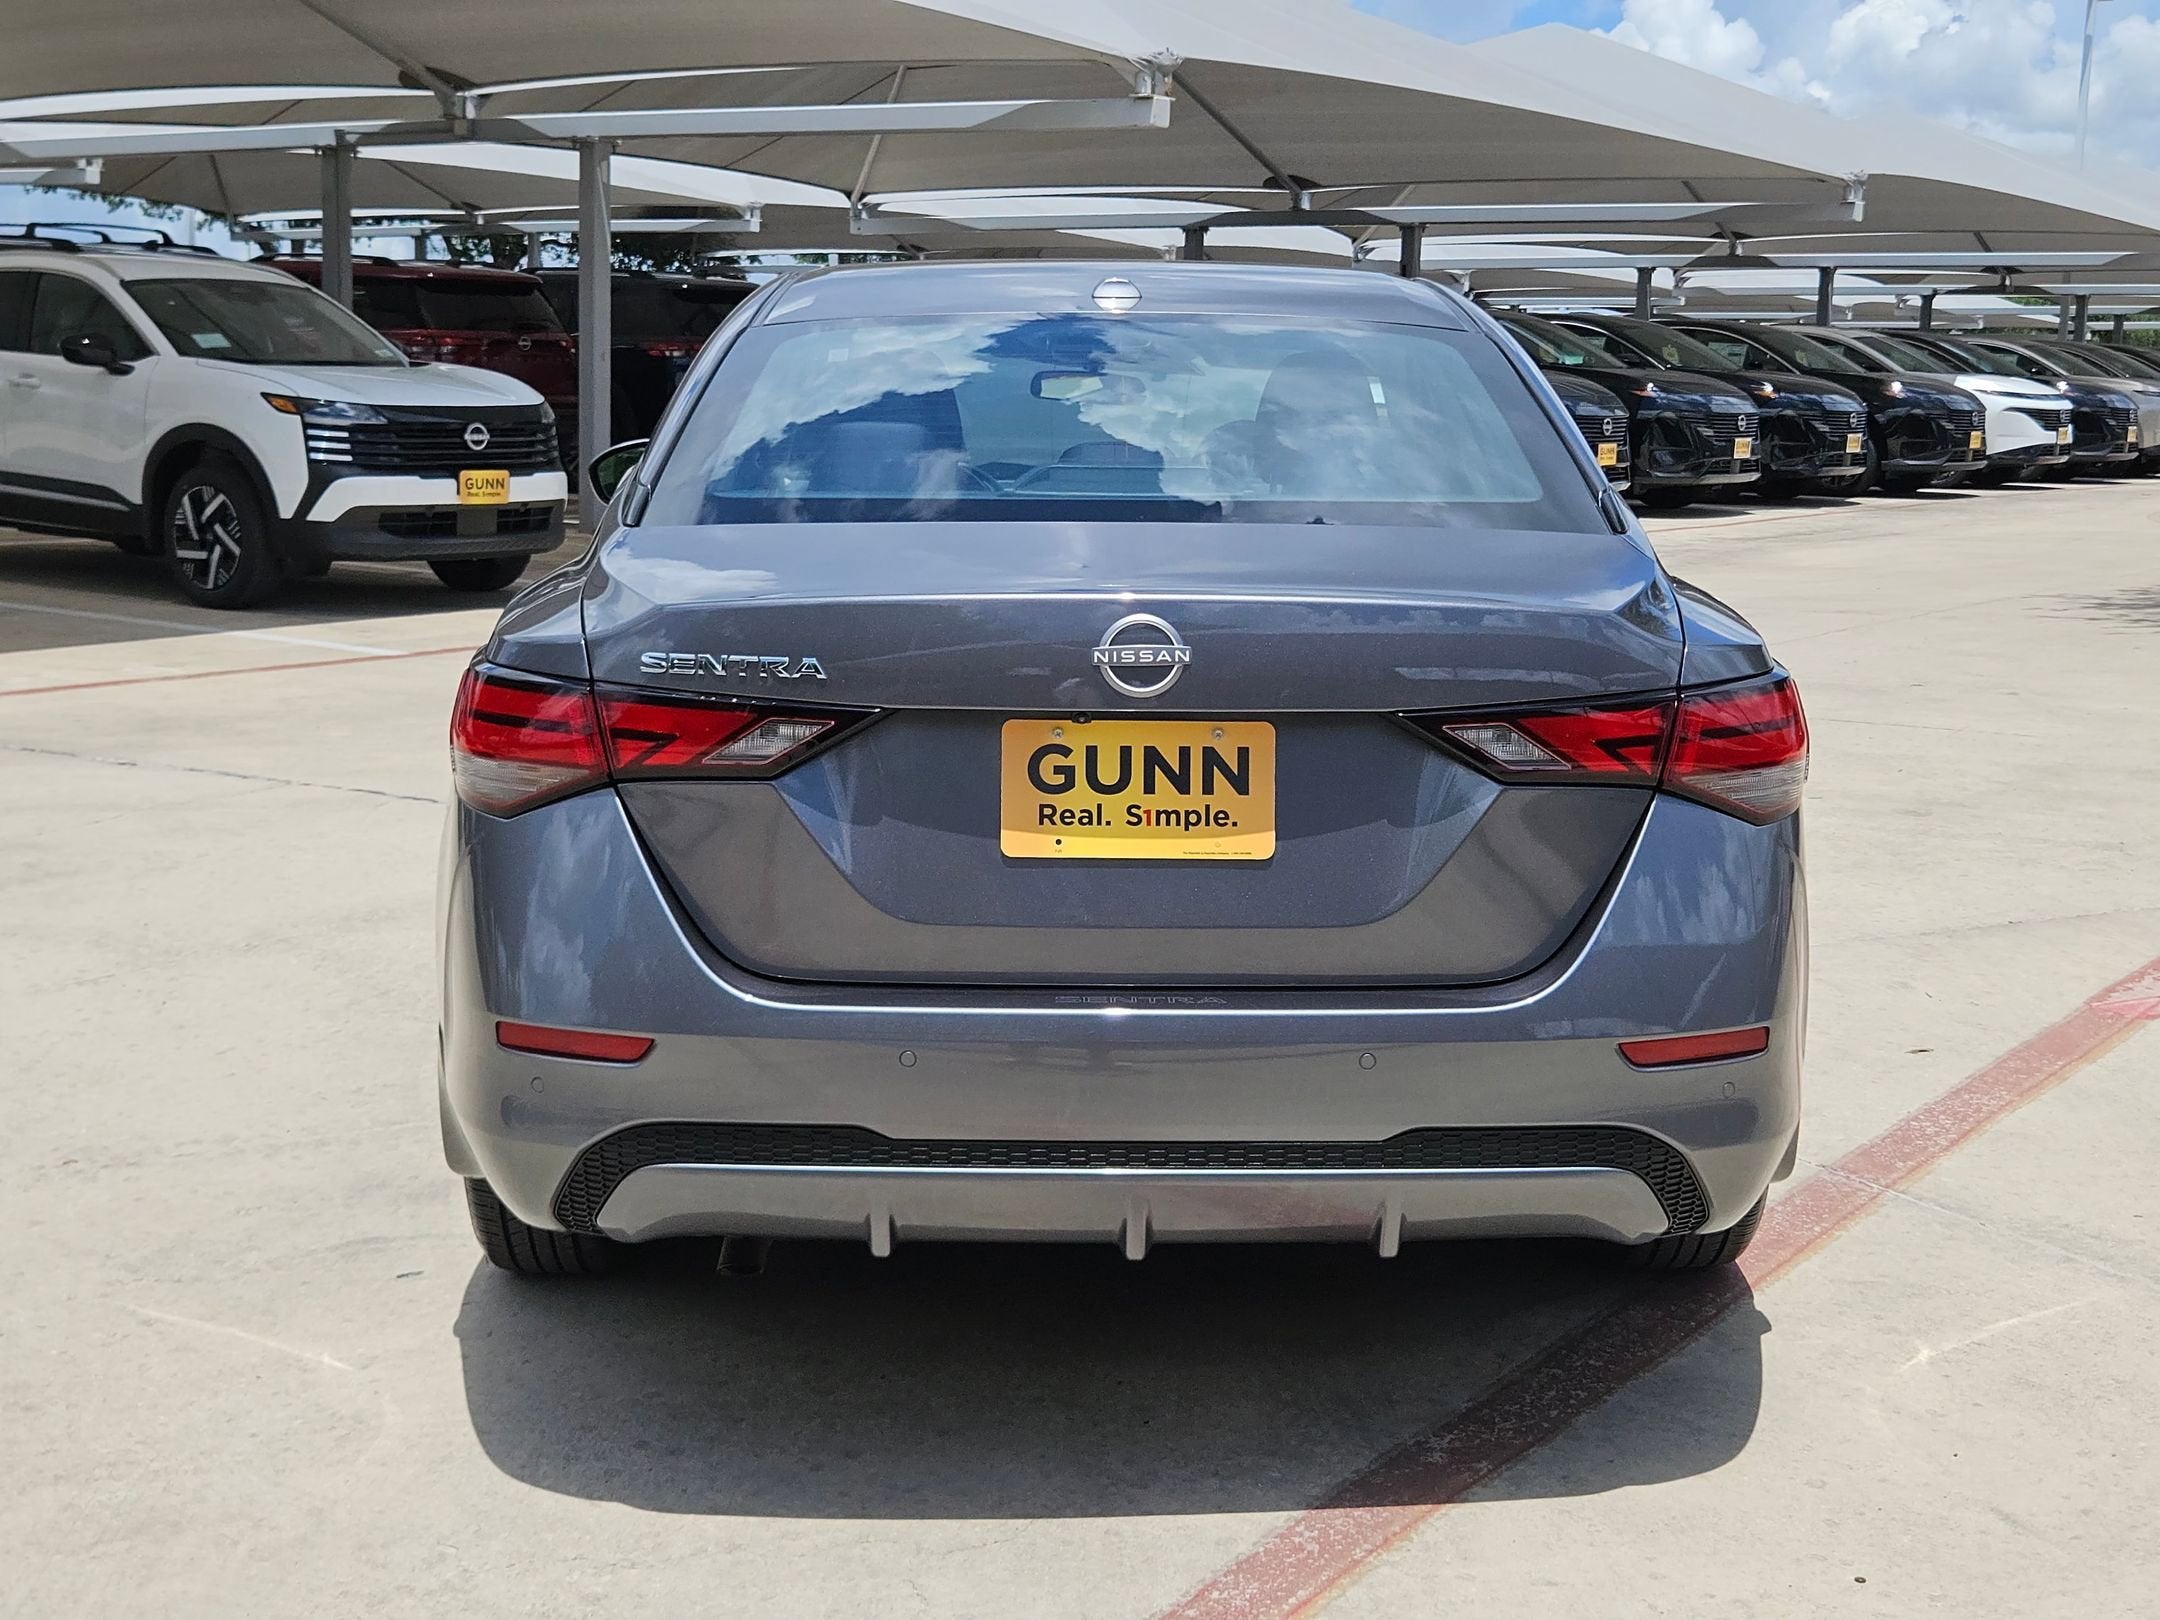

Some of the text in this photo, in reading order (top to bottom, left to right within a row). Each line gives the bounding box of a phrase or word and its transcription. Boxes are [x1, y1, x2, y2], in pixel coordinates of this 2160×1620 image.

[465, 478, 505, 490] GUNN
[640, 652, 828, 679] SENTRA
[1093, 650, 1190, 663] NISSAN
[1027, 743, 1250, 796] GUNN
[1038, 803, 1112, 826] Real.
